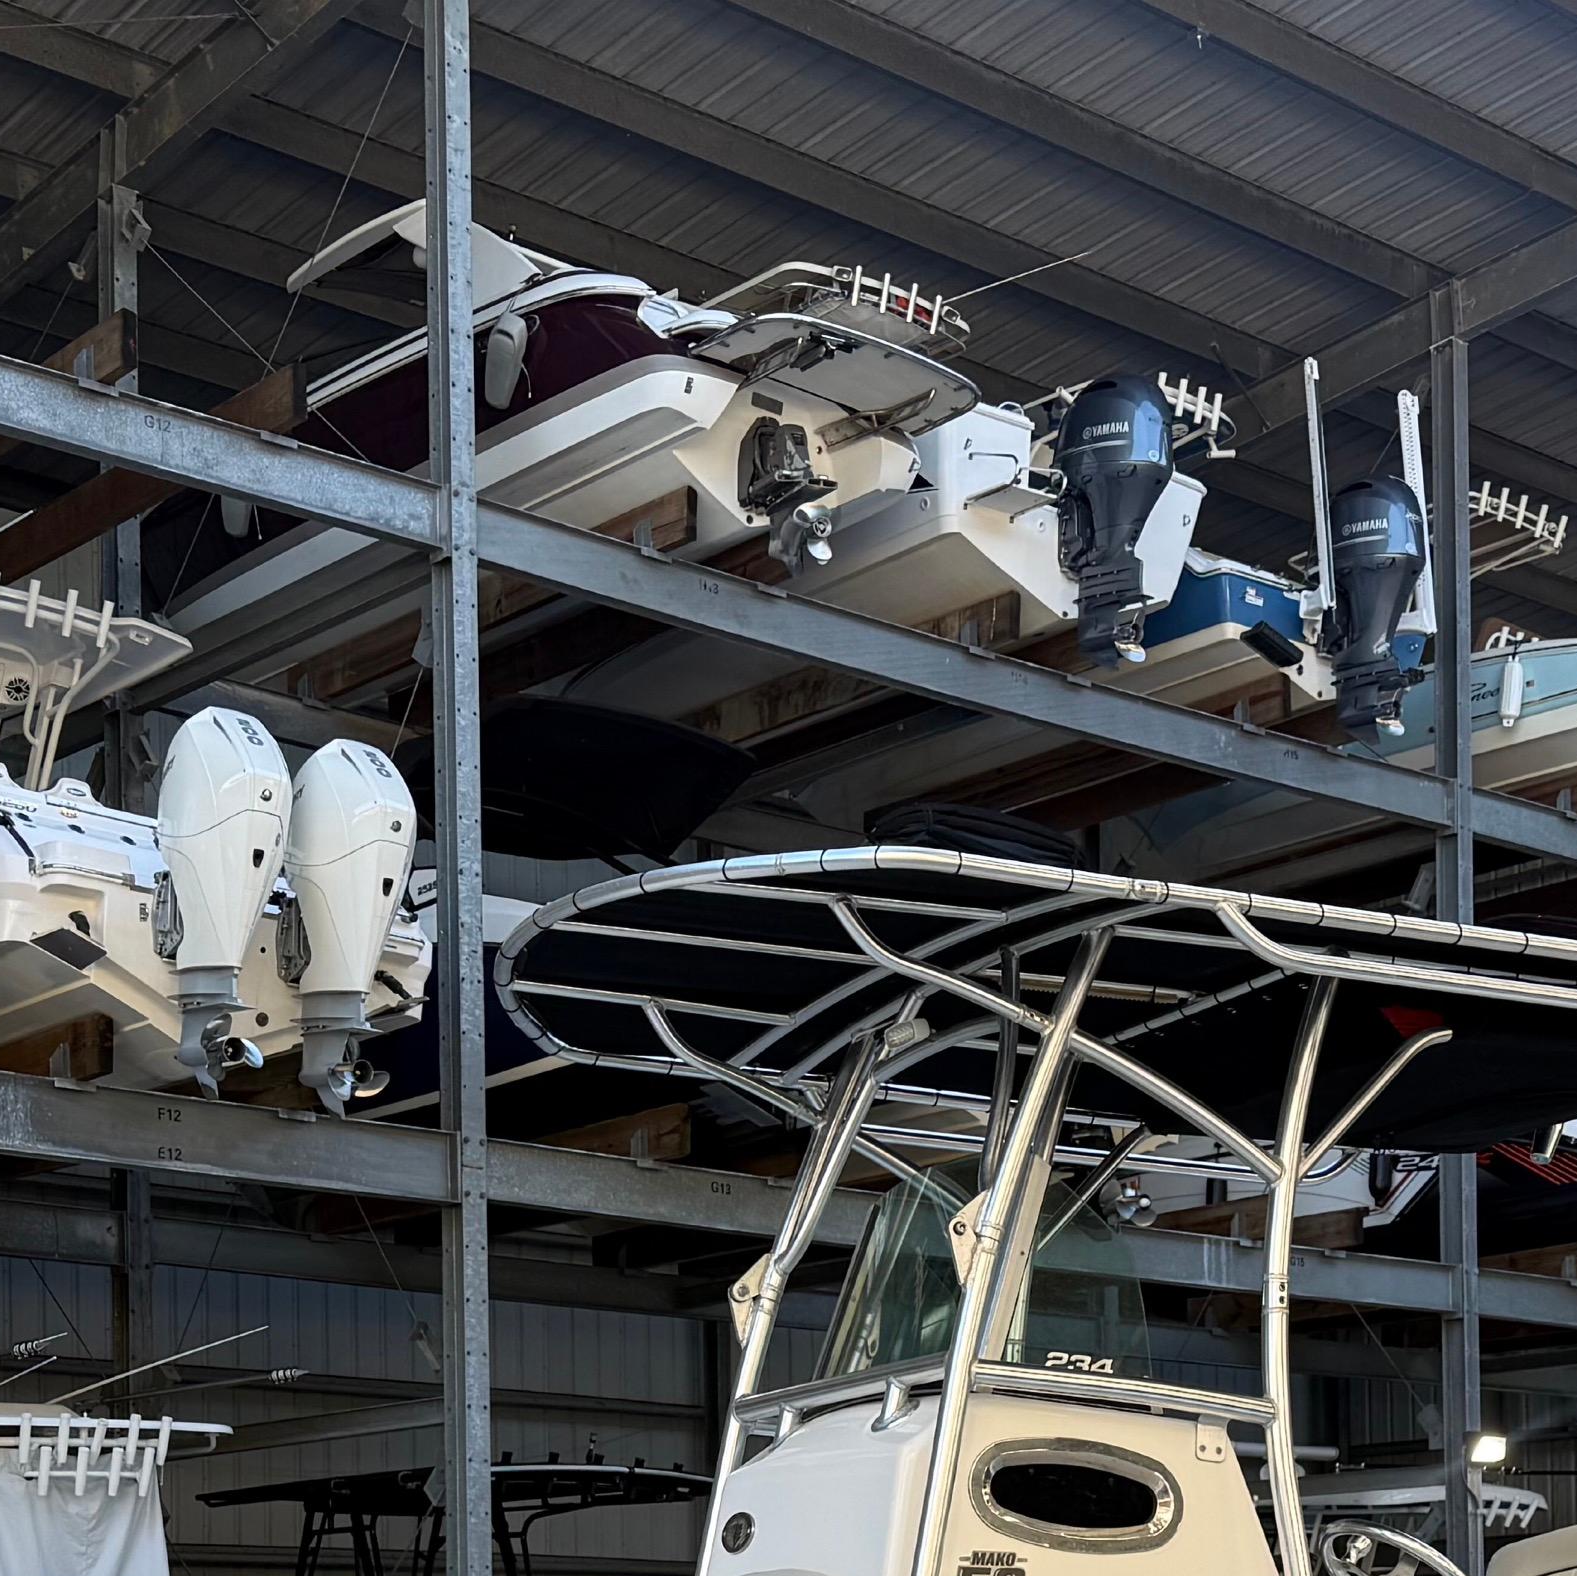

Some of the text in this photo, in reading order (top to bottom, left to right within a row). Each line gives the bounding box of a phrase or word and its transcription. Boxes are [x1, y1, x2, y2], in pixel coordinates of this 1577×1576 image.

[144, 415, 171, 433] G12
[1091, 420, 1129, 437] YAMAHA
[1351, 517, 1389, 534] YAMAHA
[158, 1107, 182, 1122] F12
[158, 1146, 182, 1161] E12
[711, 1181, 731, 1195] G13
[1045, 1351, 1114, 1374] 234
[970, 1550, 1016, 1566] MAKO
